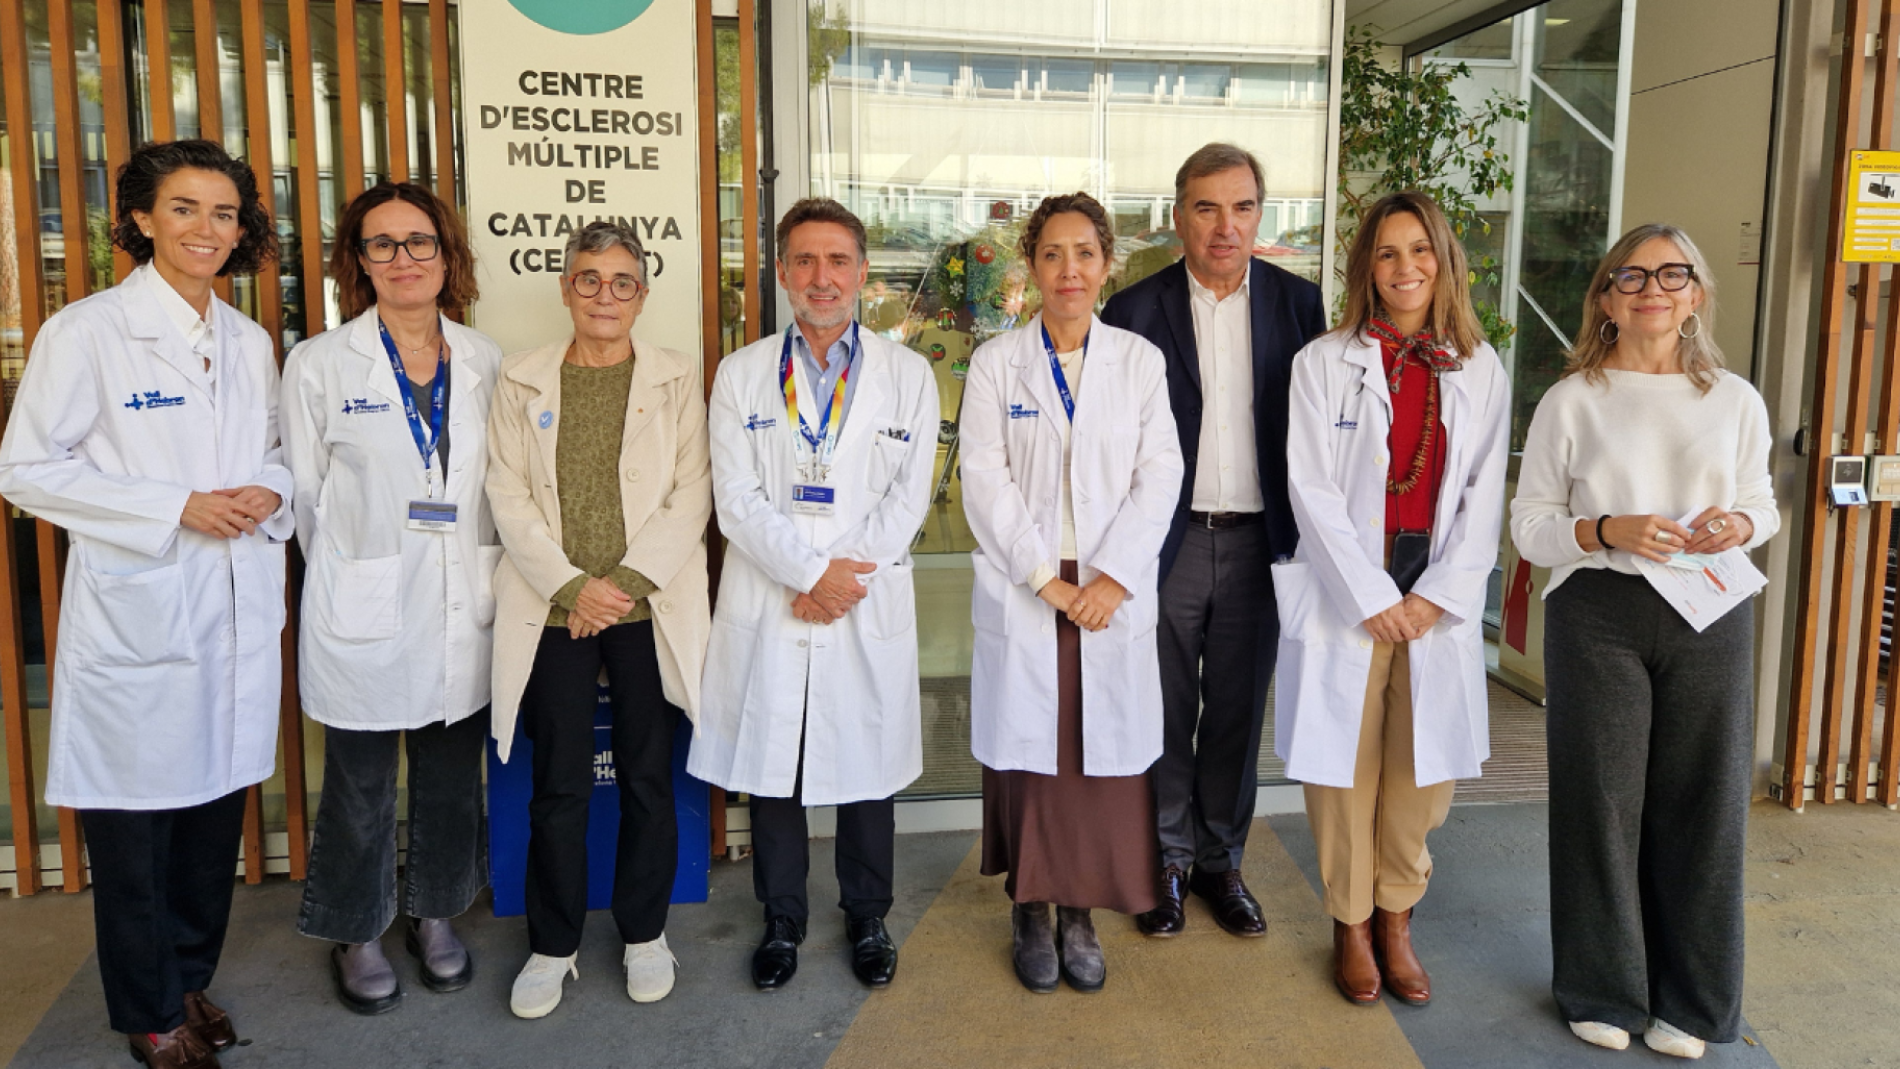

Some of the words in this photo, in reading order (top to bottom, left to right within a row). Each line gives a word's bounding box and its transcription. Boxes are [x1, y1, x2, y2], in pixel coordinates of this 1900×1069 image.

[518, 70, 643, 99] CENTRE
[480, 105, 682, 136] D'ESCLEROSI
[507, 136, 660, 170] MÚLTIPLE
[565, 179, 606, 203] DE
[488, 212, 682, 240] CATANYA
[593, 751, 613, 764] all
